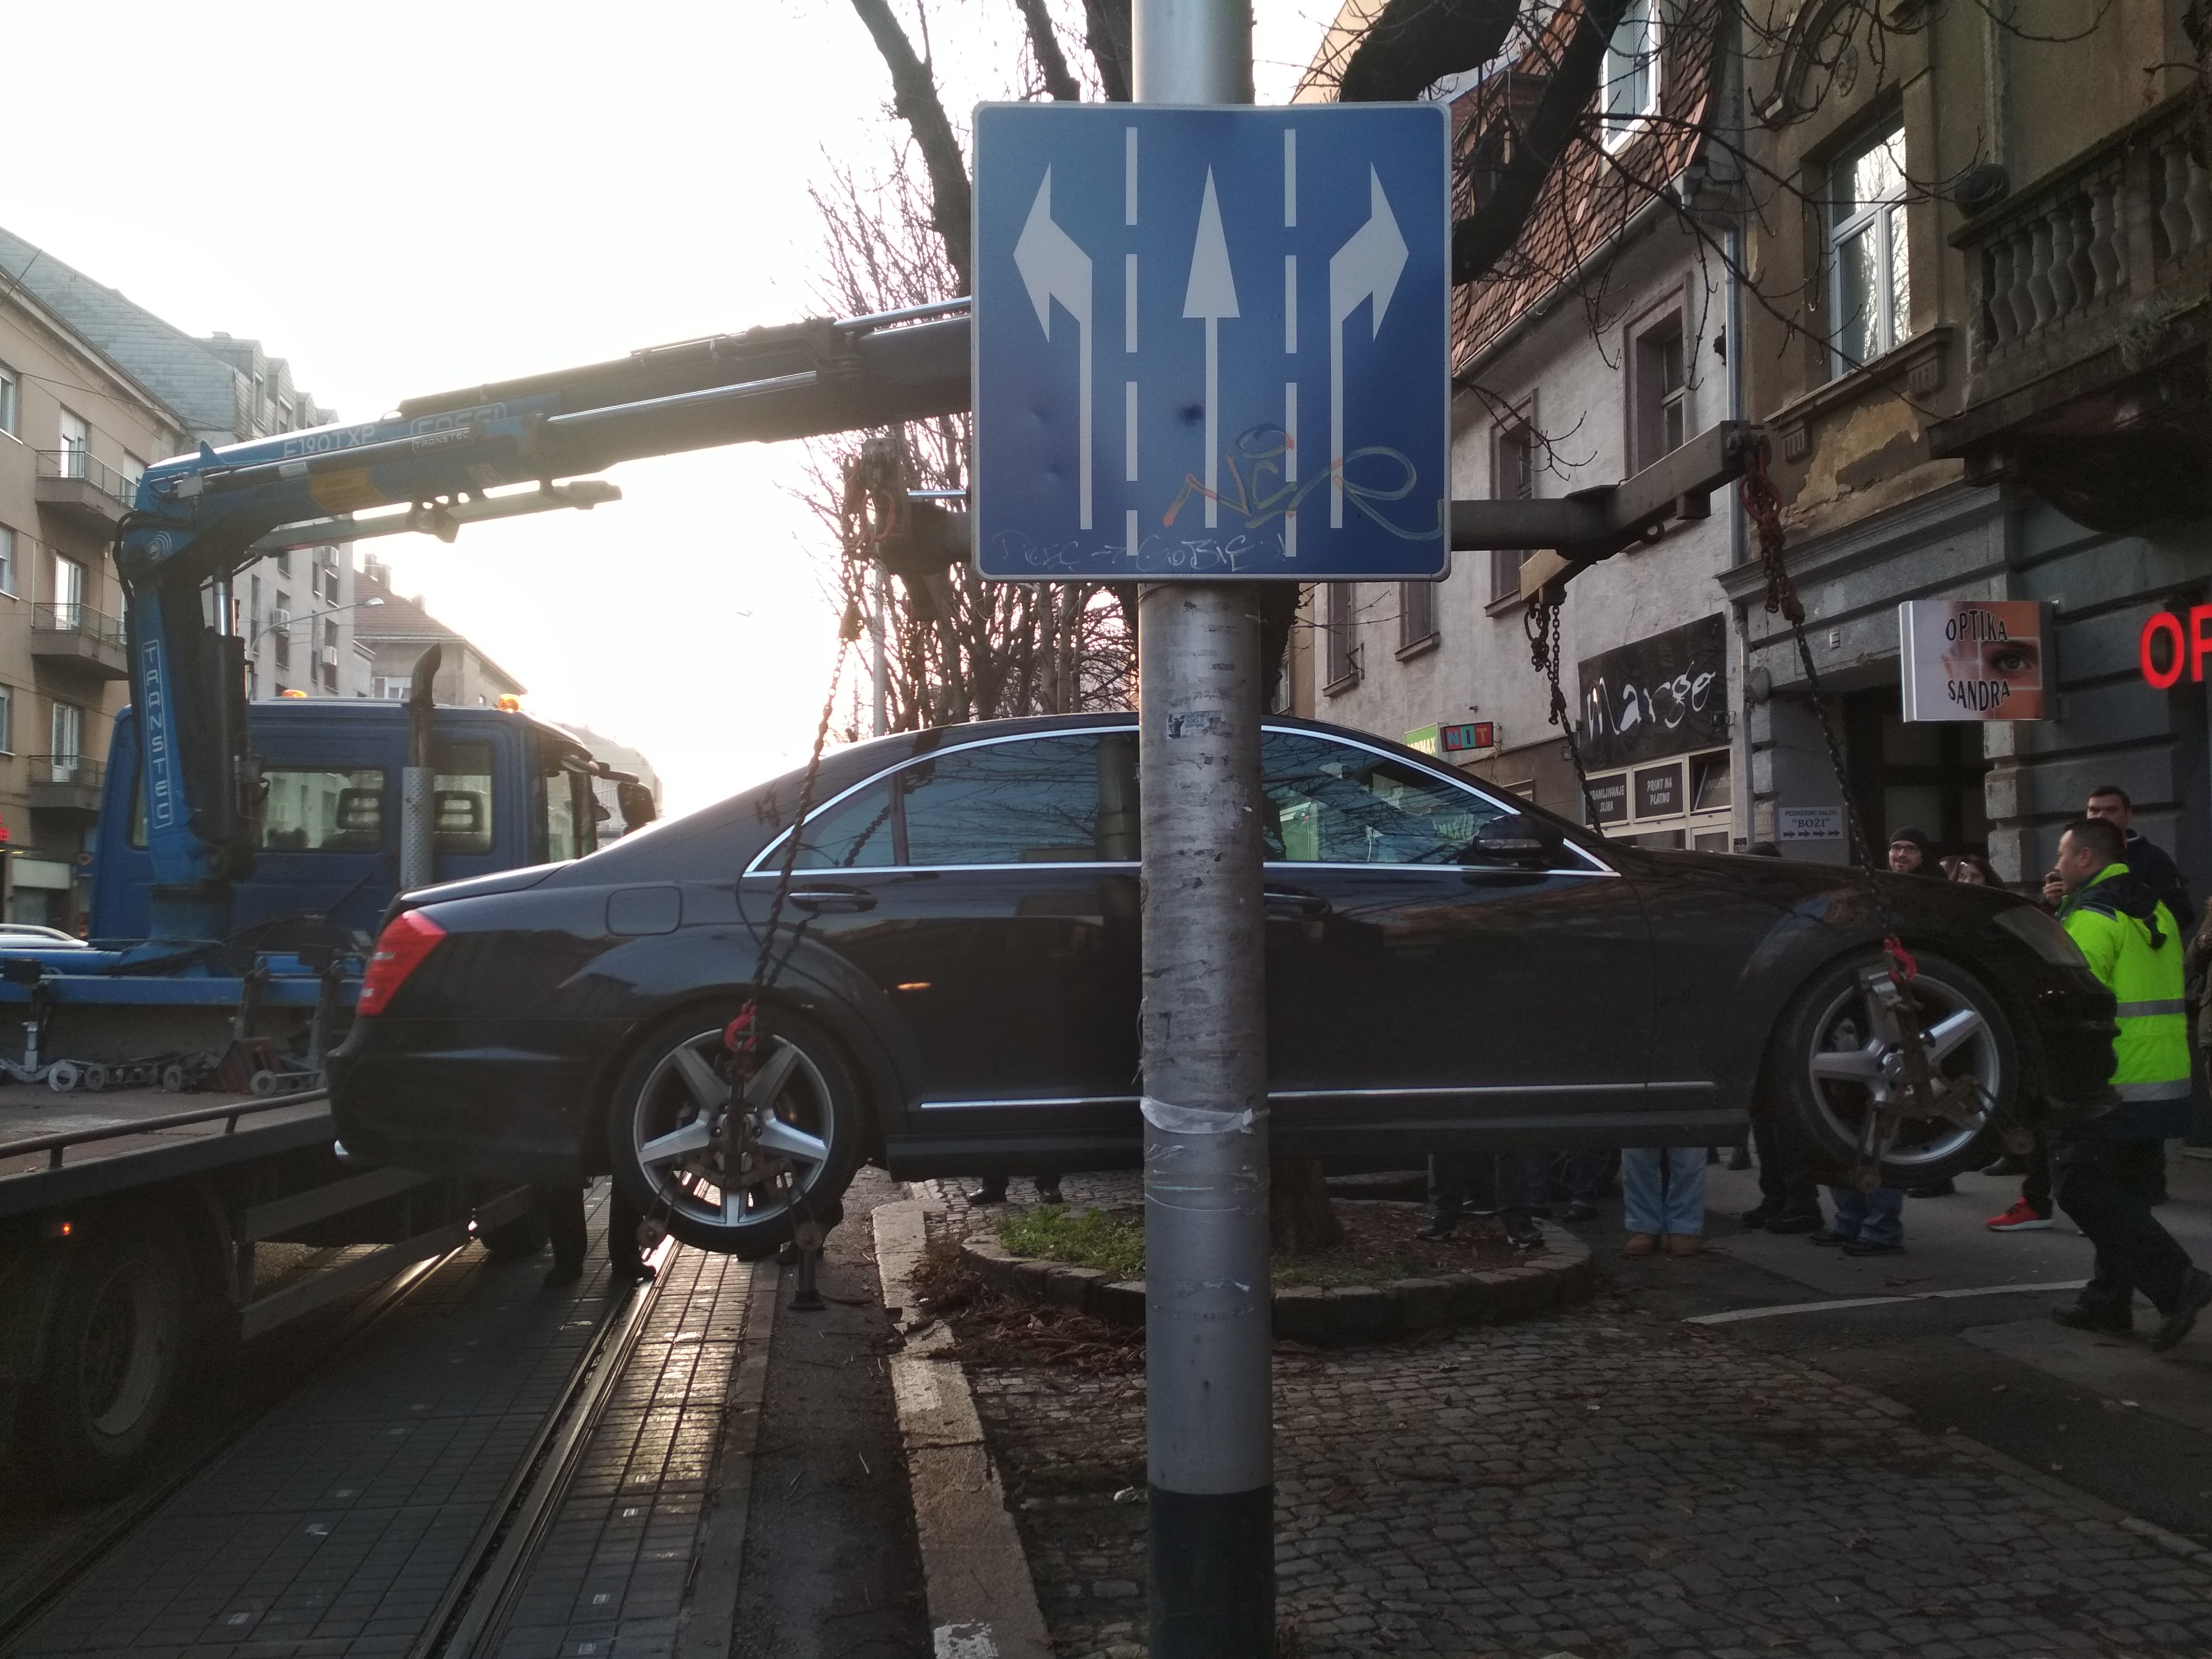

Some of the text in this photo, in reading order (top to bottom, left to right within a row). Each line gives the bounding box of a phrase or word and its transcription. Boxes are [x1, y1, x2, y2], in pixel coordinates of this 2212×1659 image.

[415, 430, 470, 448] TRANSTEC
[1946, 610, 2008, 641] OPTIKA
[1948, 680, 2010, 711] SANDRA
[144, 646, 169, 820] TRANSTEC
[1447, 727, 1487, 746] NIT
[1647, 776, 1672, 792] PRINT NA
[1599, 801, 1613, 812] SLIKA
[1650, 793, 1670, 806] PLATNO
